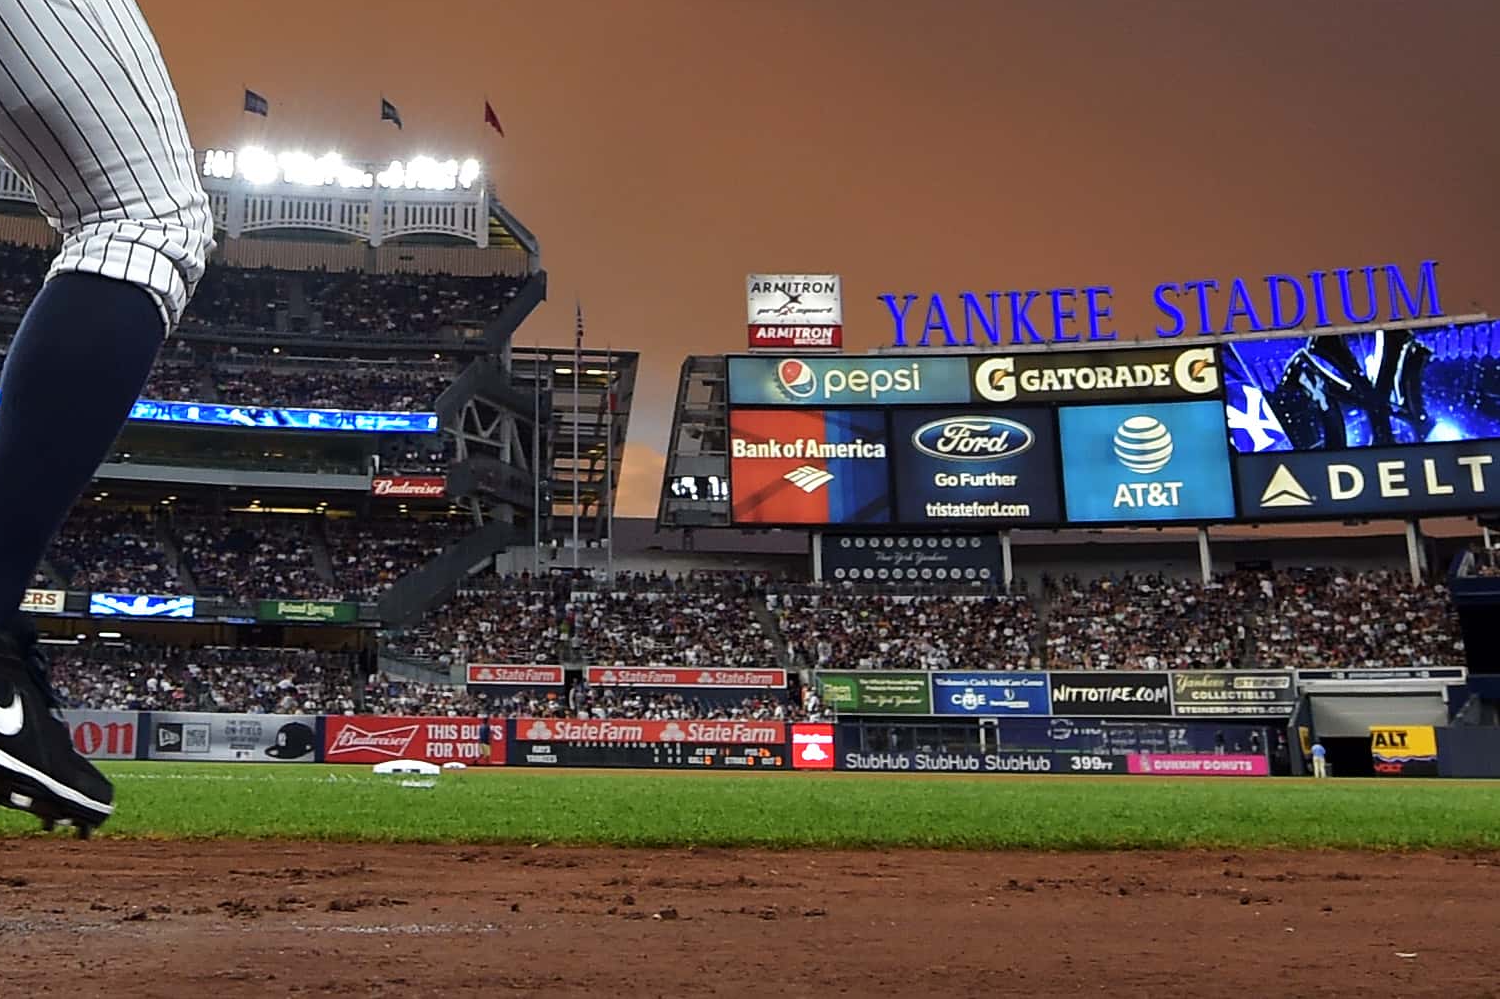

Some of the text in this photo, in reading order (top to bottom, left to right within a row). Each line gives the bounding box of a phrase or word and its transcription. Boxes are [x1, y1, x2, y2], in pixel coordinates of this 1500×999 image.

[751, 281, 836, 294] ARMITRON
[877, 258, 1444, 347] YANKEE STADIUM
[755, 327, 833, 339] ARMITRON
[824, 363, 921, 398] pepsi
[1020, 363, 1172, 392] GATORADE
[936, 423, 1009, 453] Ford
[372, 479, 445, 495] Budweiser
[935, 472, 1017, 487] Go Further
[1113, 481, 1183, 508] AT&T
[926, 502, 1030, 517] tristateford.com
[1053, 683, 1168, 702] NITTOTIRE.COM
[338, 731, 411, 747] Budweiser
[426, 724, 503, 741] THIS BU'S
[1373, 732, 1408, 747] ALT
[426, 742, 454, 758] FOR
[845, 753, 1051, 771] StubHub StubHub StubHub
